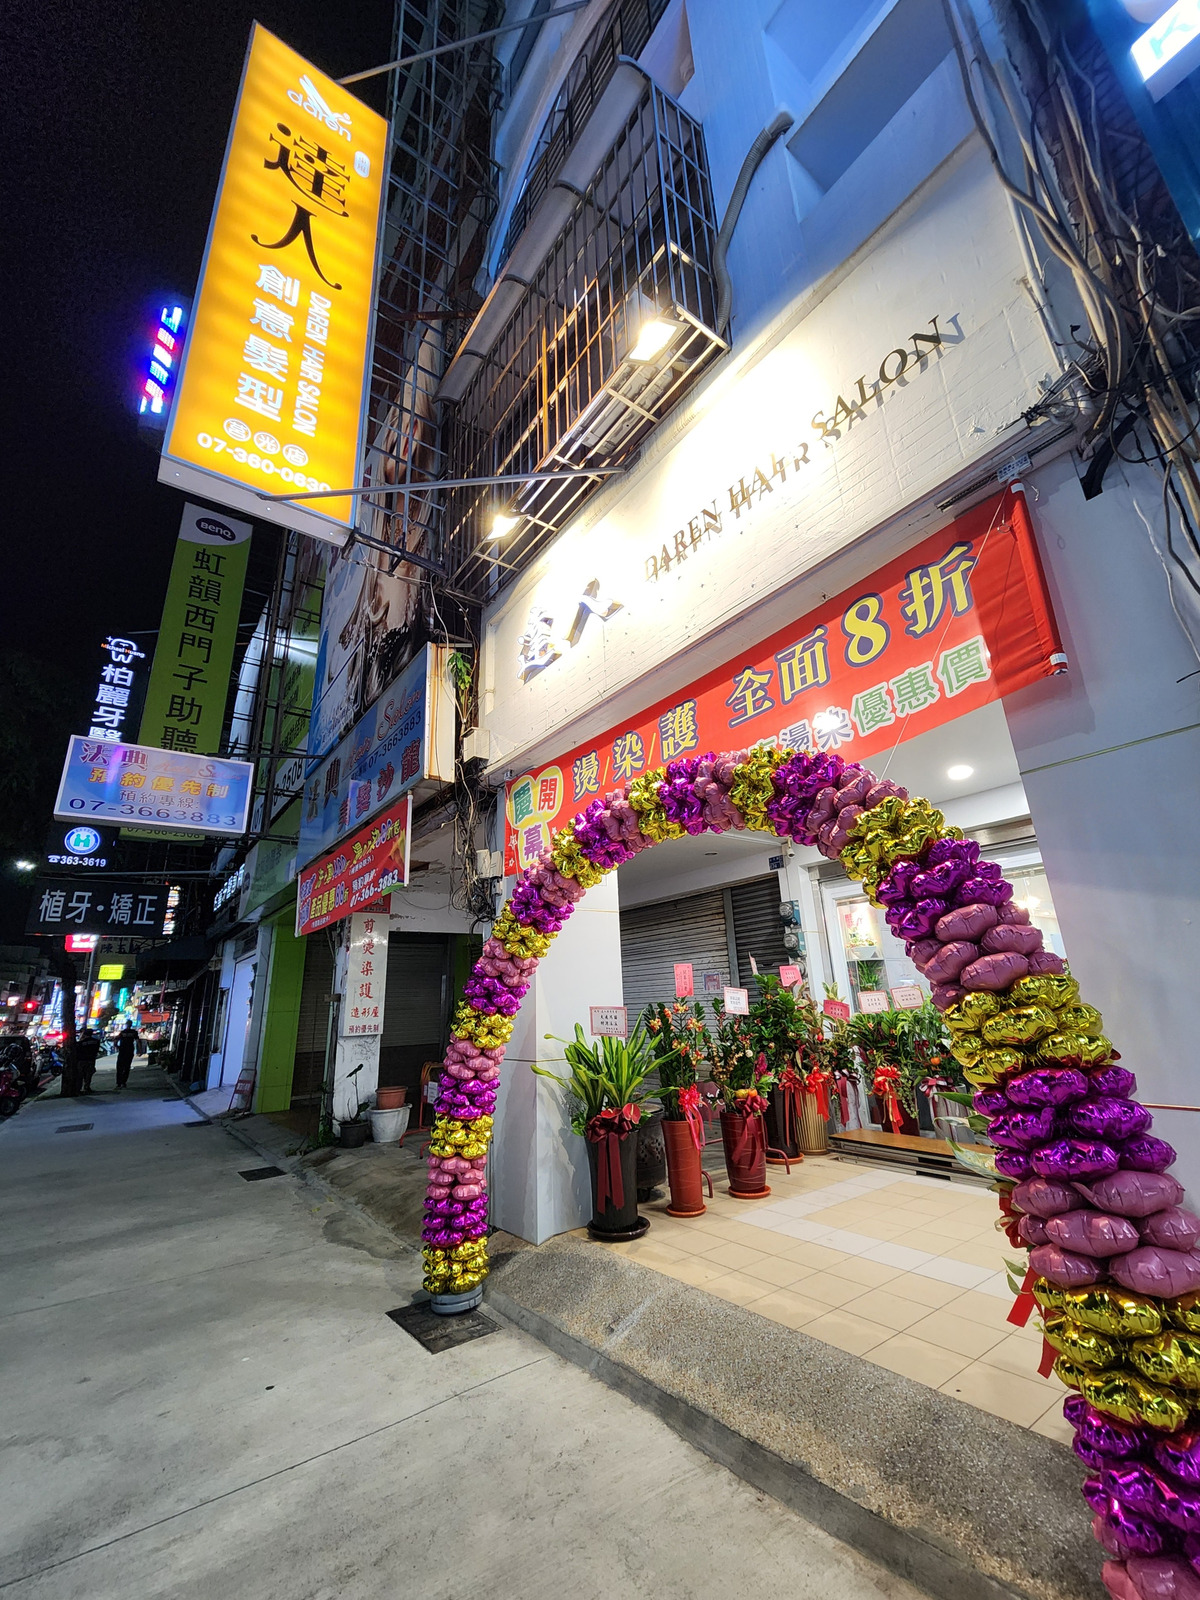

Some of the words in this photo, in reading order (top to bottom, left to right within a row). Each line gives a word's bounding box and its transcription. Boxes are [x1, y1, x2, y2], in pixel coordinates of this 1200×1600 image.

[251, 122, 350, 290] 達人
[234, 264, 300, 422] 創意髮型
[305, 290, 332, 346] DAREN
[299, 344, 325, 383] HAIR
[292, 381, 321, 437] SALON
[644, 499, 720, 581] DAREN
[728, 443, 810, 515] HAIR
[812, 314, 942, 440] SALON
[200, 522, 233, 539] BenQ
[726, 540, 978, 729] 全面8折
[368, 711, 422, 773] 07-3663883
[88, 766, 229, 798] 預約優先制
[69, 797, 237, 826] 07-3663883
[59, 855, 107, 868] 363-3619
[349, 869, 399, 908] 07-366-3883
